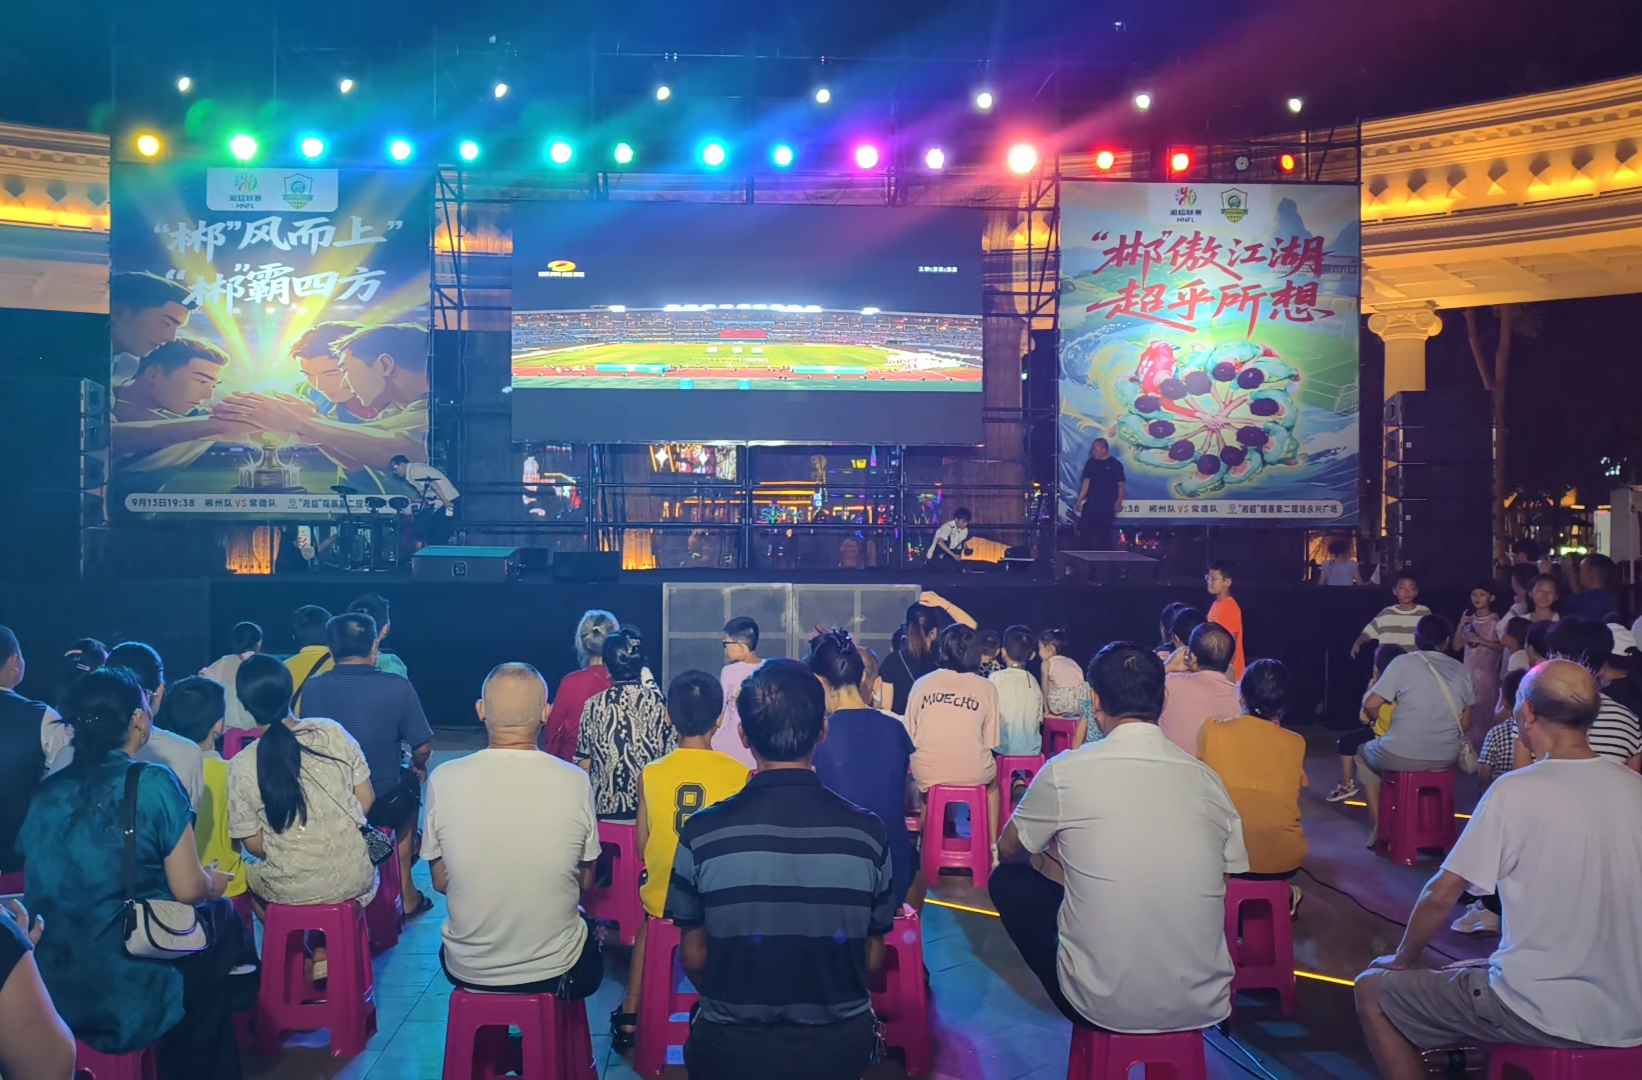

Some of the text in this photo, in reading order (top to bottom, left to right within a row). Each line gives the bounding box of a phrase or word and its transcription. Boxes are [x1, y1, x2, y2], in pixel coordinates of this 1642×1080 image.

[1086, 278, 1335, 339] 超乎所想
[235, 499, 247, 508] VS
[249, 498, 277, 508] 常德队
[1178, 504, 1189, 513] VS
[1191, 504, 1218, 513] 常德队
[673, 782, 706, 837] 8
